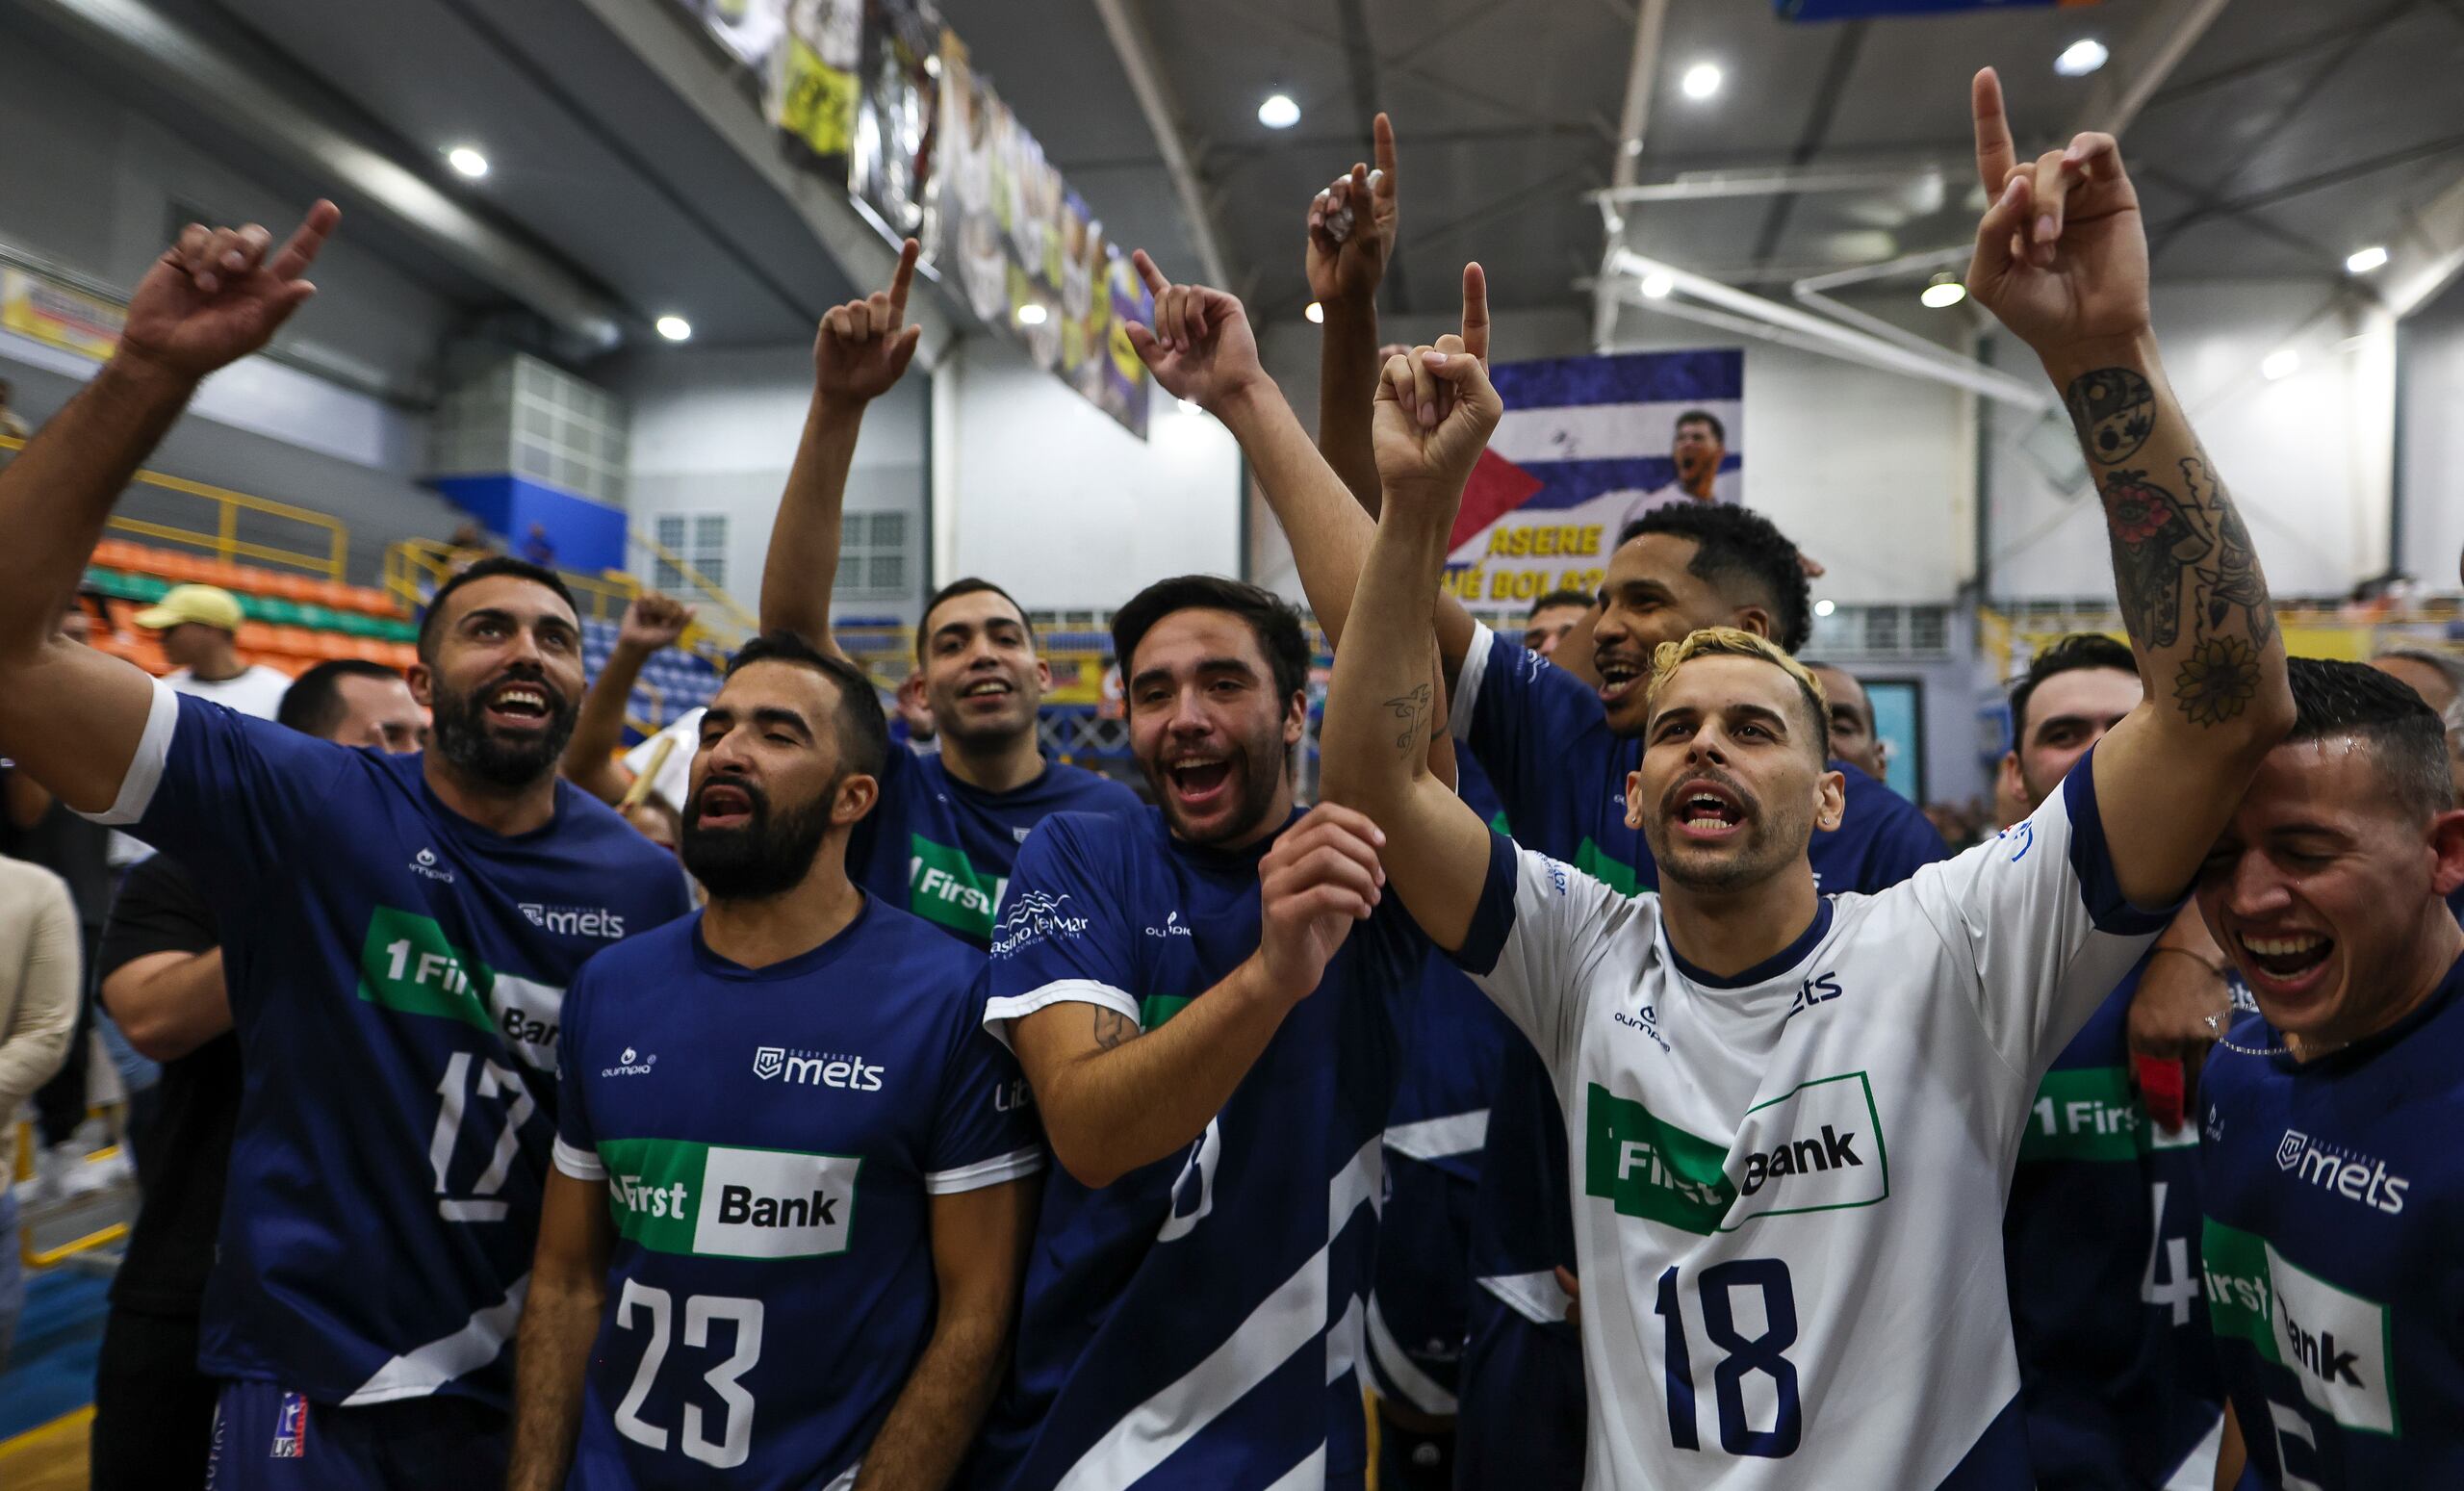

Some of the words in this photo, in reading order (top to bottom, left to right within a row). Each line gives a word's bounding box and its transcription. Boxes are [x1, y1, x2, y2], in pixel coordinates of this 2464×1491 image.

[1488, 524, 1604, 556] ASERE
[1443, 558, 1483, 600] UÉ
[547, 908, 624, 938] mets
[990, 927, 1031, 954] asino
[386, 939, 410, 980] 1
[783, 1056, 884, 1092] mets
[2034, 1096, 2057, 1136] 1
[1741, 1124, 1862, 1196] Bank
[2298, 1147, 2409, 1215] mets
[719, 1185, 839, 1227] Bank
[2202, 1259, 2268, 1321] irst
[2280, 1299, 2366, 1389] ank
[614, 1276, 764, 1469] 23
[1655, 1258, 1802, 1459] 18
